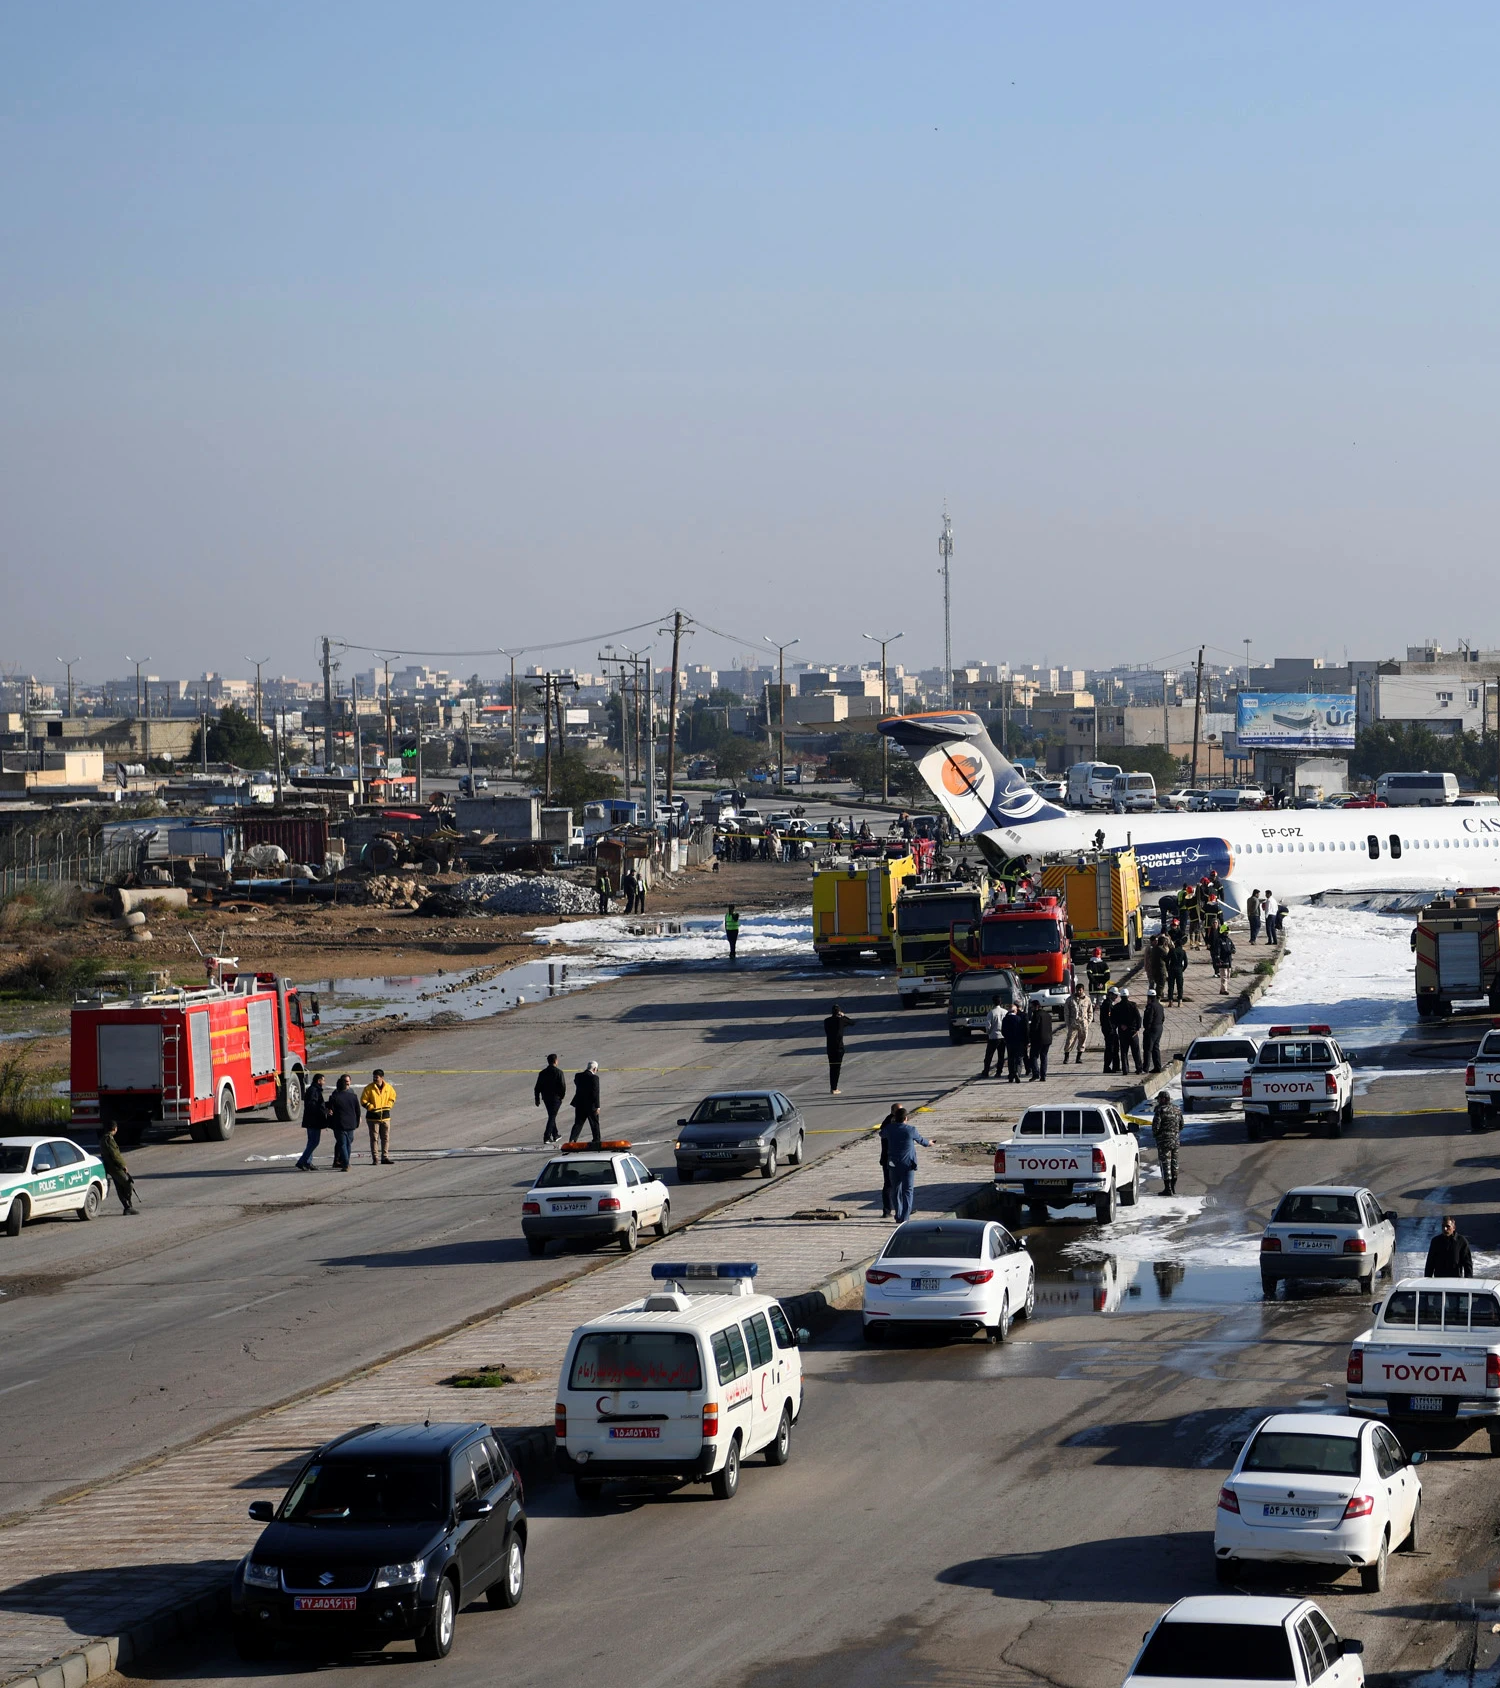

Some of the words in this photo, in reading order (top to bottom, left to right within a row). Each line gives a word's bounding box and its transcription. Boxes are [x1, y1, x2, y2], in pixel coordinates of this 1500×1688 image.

[1261, 827, 1304, 838] EP-CPZ
[1135, 850, 1187, 863] CDONNELL
[1136, 858, 1183, 869] OUGLAS
[956, 1004, 995, 1015] FOLLOW
[1263, 1083, 1315, 1094] TOYOTA
[1018, 1158, 1079, 1170] TOYOTA
[68, 1170, 84, 1186] پلیس
[38, 1179, 57, 1192] POLICE
[1381, 1363, 1468, 1382] TOYOTA
